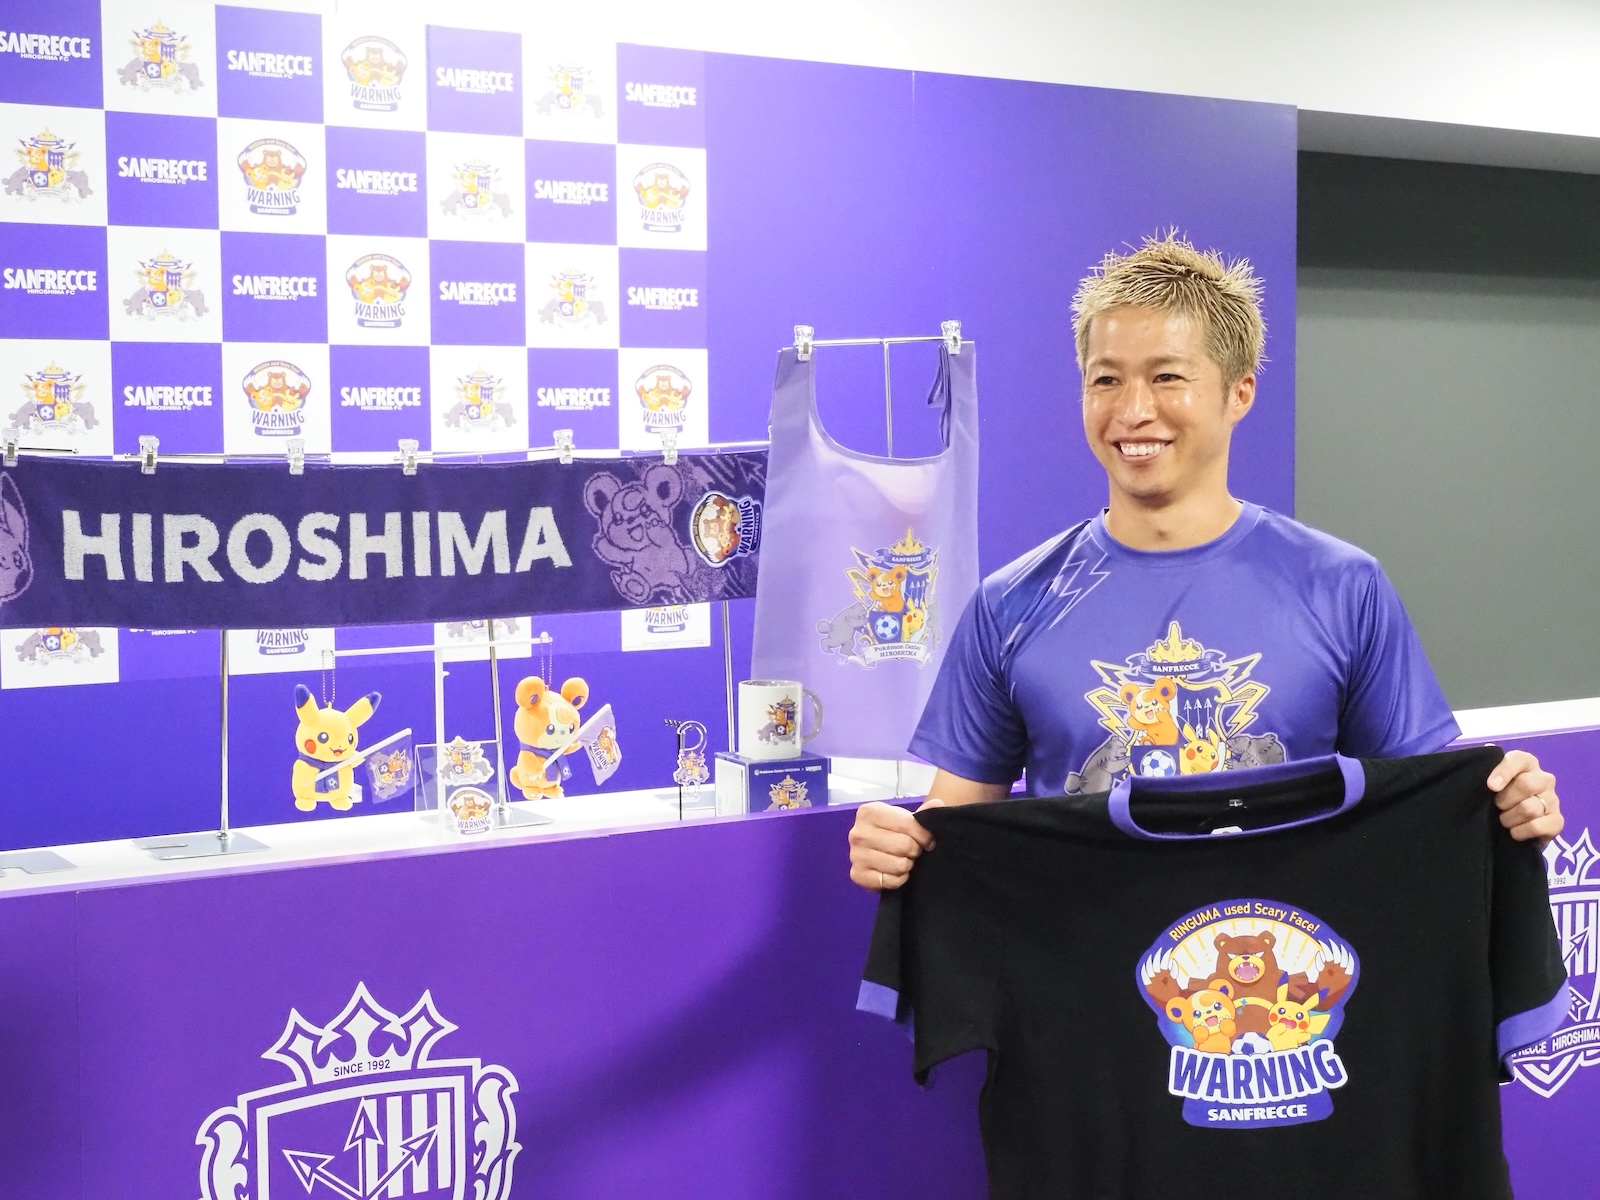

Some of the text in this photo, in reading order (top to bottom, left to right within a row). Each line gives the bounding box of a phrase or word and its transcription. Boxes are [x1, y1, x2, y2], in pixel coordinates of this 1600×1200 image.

[0, 31, 91, 58] SANFRECCE
[21, 53, 58, 61] HIROSHIMA
[227, 50, 312, 76] SANFRECCE
[436, 67, 513, 91] SANFRECCE
[350, 83, 402, 103] WARNING
[625, 82, 696, 105] SANFRECCE
[118, 156, 207, 181] SANFRECCE
[337, 168, 417, 192] SANFRECCE
[534, 179, 608, 201] SANFRECCE
[247, 188, 301, 206] WARNING
[640, 207, 685, 225] WARNING
[4, 268, 97, 290] SANFRECCE
[233, 275, 317, 296] SANFRECCE
[439, 281, 516, 302] SANFRECCE
[628, 286, 698, 306] SANFRECCE
[354, 302, 405, 319] WARNING
[124, 386, 212, 406] SANFRECCE
[341, 387, 421, 406] SANFRECCE
[537, 387, 610, 407] SANFRECCE
[251, 410, 305, 428] WARNING
[642, 409, 687, 426] WARNING
[738, 500, 753, 554] WARNING
[62, 506, 573, 584] HIROSHIMA
[645, 608, 689, 625] WARNING
[256, 629, 309, 646] WARNING
[1152, 663, 1200, 673] SANFRECCE
[457, 816, 491, 829] WARNING
[1169, 902, 1320, 942] RINGUMA used Scary Face!
[1552, 1027, 1600, 1052] HIROSHIMA
[333, 1059, 391, 1077] SINCE 1992
[1172, 1043, 1344, 1100] WARNING
[1207, 1104, 1308, 1122] SANFRECCE
